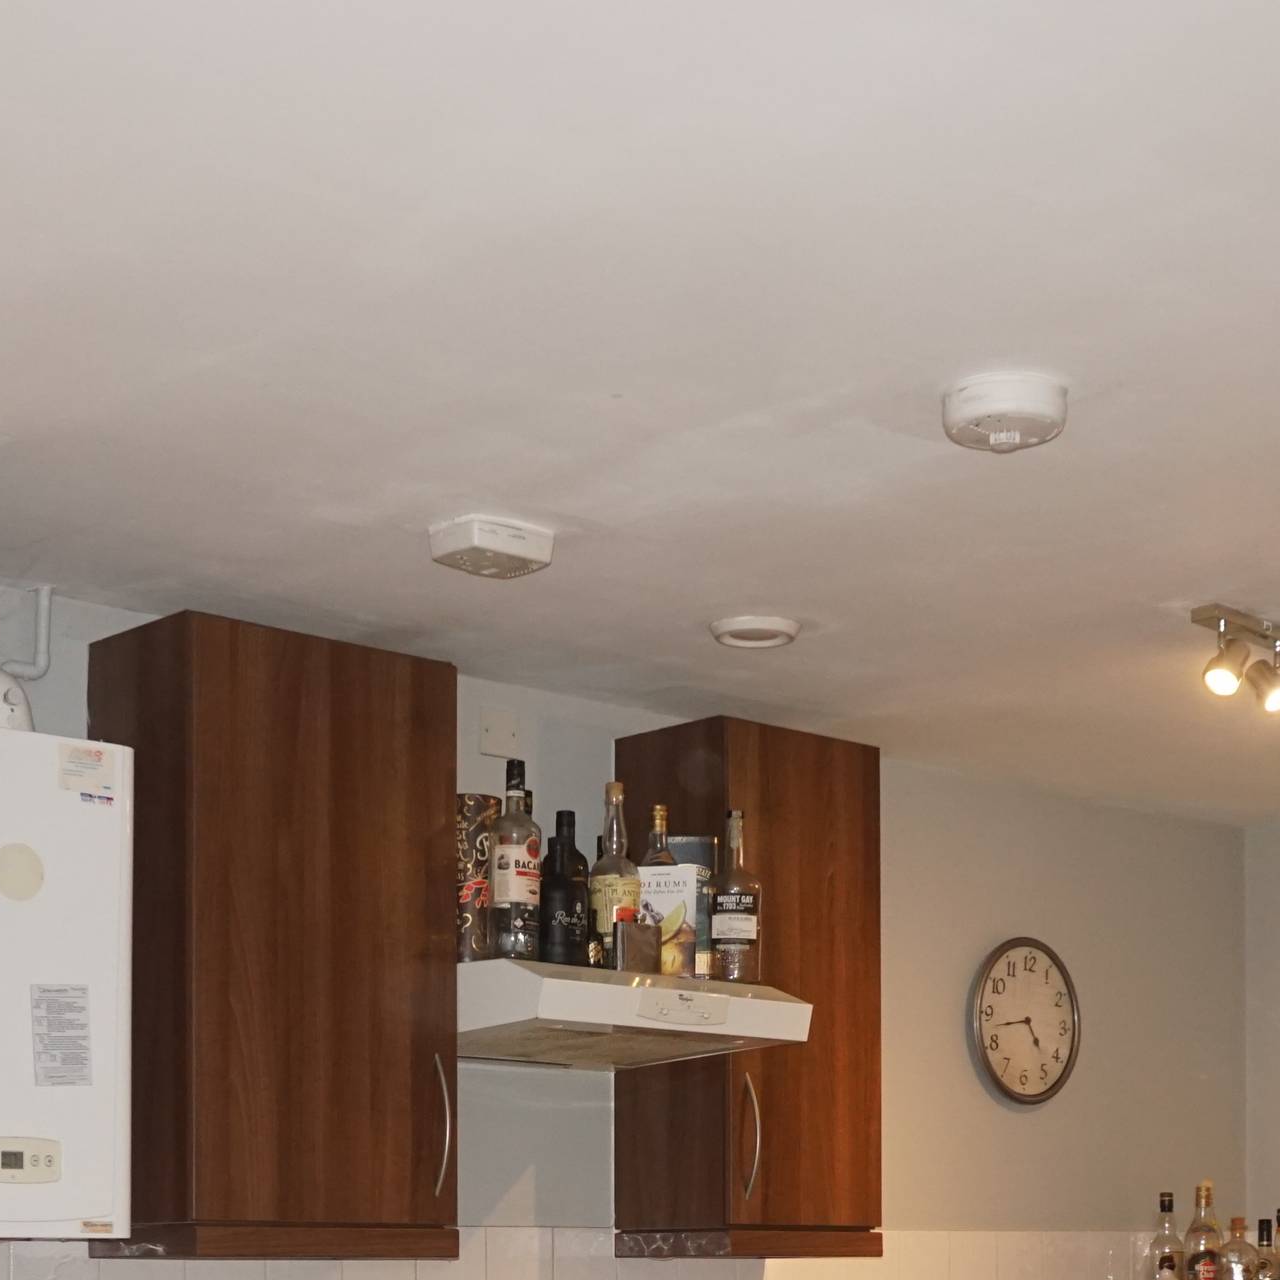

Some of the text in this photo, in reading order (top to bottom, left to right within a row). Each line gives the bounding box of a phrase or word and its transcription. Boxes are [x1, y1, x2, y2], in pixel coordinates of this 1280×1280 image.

[717, 895, 754, 904] MOUNT GAY
[1007, 961, 1017, 978] 11
[1023, 955, 1037, 973] 12
[1045, 968, 1050, 984] 1
[992, 978, 1006, 995] 10
[1055, 992, 1063, 1008] 2
[985, 1005, 994, 1022] 9
[1059, 1021, 1067, 1036] 3
[990, 1034, 999, 1051] 8
[1052, 1048, 1061, 1063] 4
[1002, 1058, 1010, 1074] 7
[1040, 1064, 1048, 1080] 5
[1019, 1070, 1028, 1086] 6
